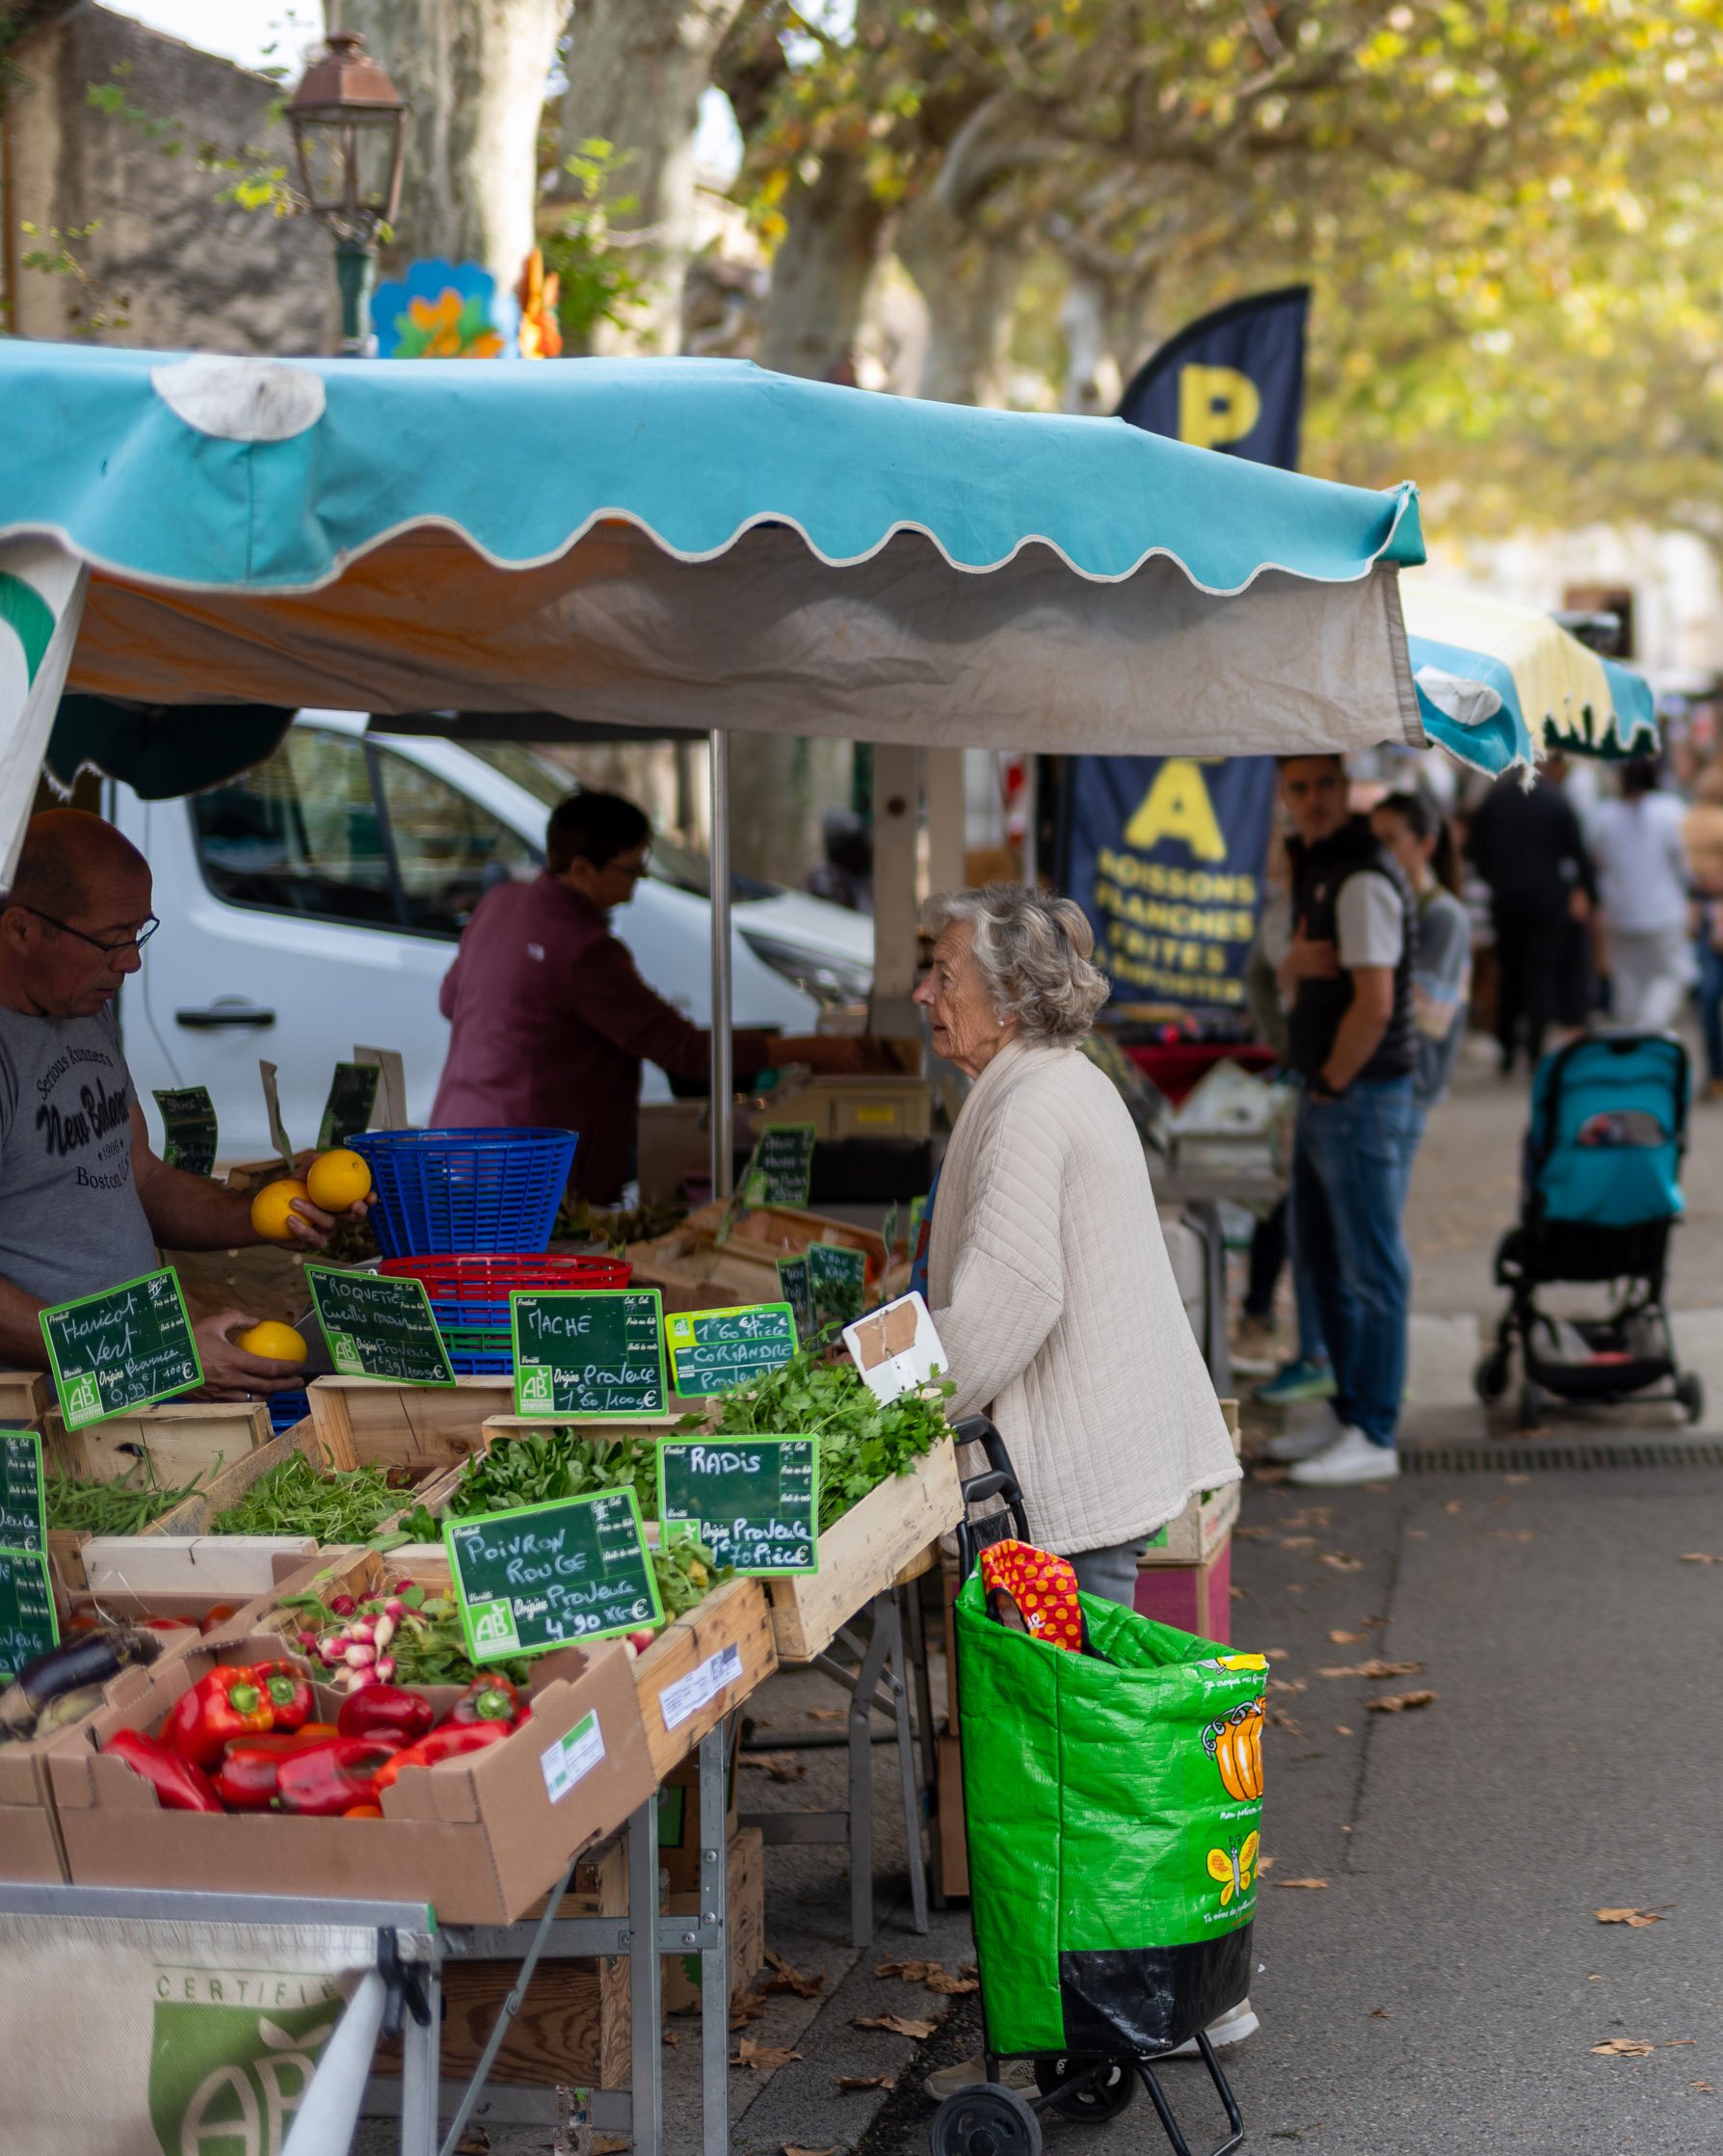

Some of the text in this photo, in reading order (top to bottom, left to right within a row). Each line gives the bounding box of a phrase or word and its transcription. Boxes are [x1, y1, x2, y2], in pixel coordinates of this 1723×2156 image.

[1180, 363, 1260, 449] P
[1123, 756, 1227, 862] A
[36, 1104, 91, 1156] New
[103, 1140, 120, 1158] 1906
[76, 1166, 122, 1189] Boston
[330, 1278, 400, 1304] ROQUETTE
[517, 1297, 538, 1306] Produit
[49, 1312, 69, 1324] Produit
[62, 1291, 138, 1344] Haricot
[374, 1313, 409, 1327] main
[528, 1308, 593, 1339] MACHE
[86, 1322, 138, 1366] Vert
[336, 1341, 356, 1360] AB
[357, 1337, 437, 1360] Origine Provence
[99, 1347, 180, 1388] Origine Provence
[554, 1362, 657, 1388] Origine Provence
[70, 1384, 95, 1411] AB
[522, 1376, 547, 1397] AB
[455, 1527, 481, 1537] Produit
[702, 1518, 813, 1544] Origine Provence
[506, 1553, 588, 1584] ROUGE
[513, 1581, 638, 1621] Origine Provence
[476, 1611, 509, 1640] AB
[156, 1976, 337, 2005] CERTIFIÉ
